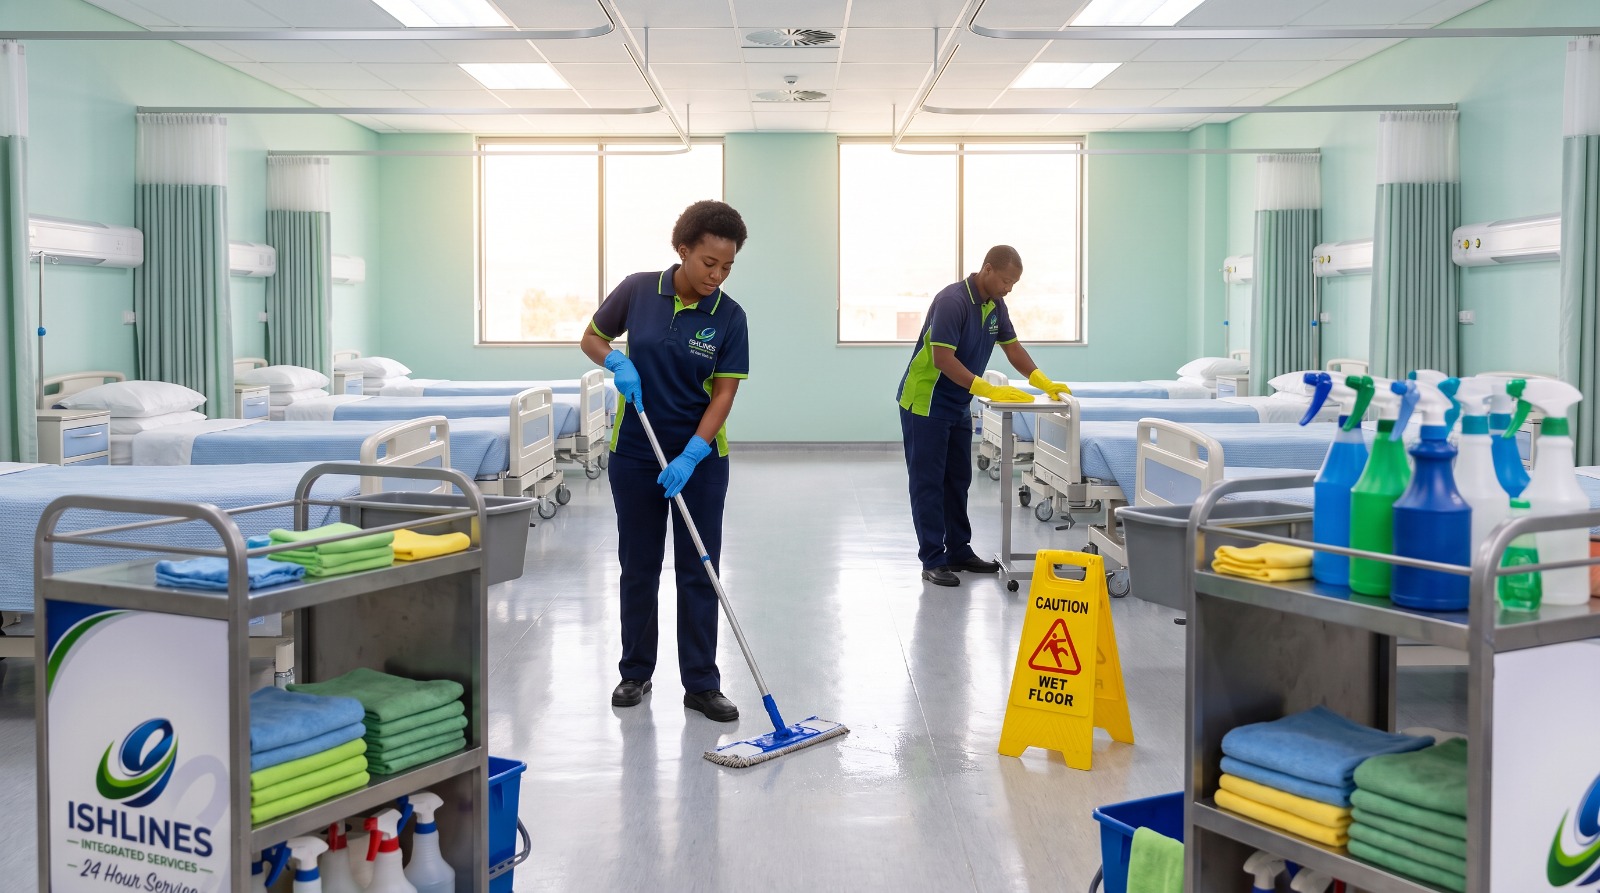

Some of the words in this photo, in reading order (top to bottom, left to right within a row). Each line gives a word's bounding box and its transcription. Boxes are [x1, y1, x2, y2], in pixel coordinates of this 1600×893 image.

[1035, 596, 1088, 614] CAUTION
[1039, 675, 1067, 690] WET
[1028, 688, 1073, 706] FLOOR
[68, 801, 213, 857] ISHLINES
[81, 839, 144, 861] INTEGRATED
[147, 853, 198, 873] SERVICES
[80, 859, 101, 879] 24
[104, 864, 141, 888] Hour
